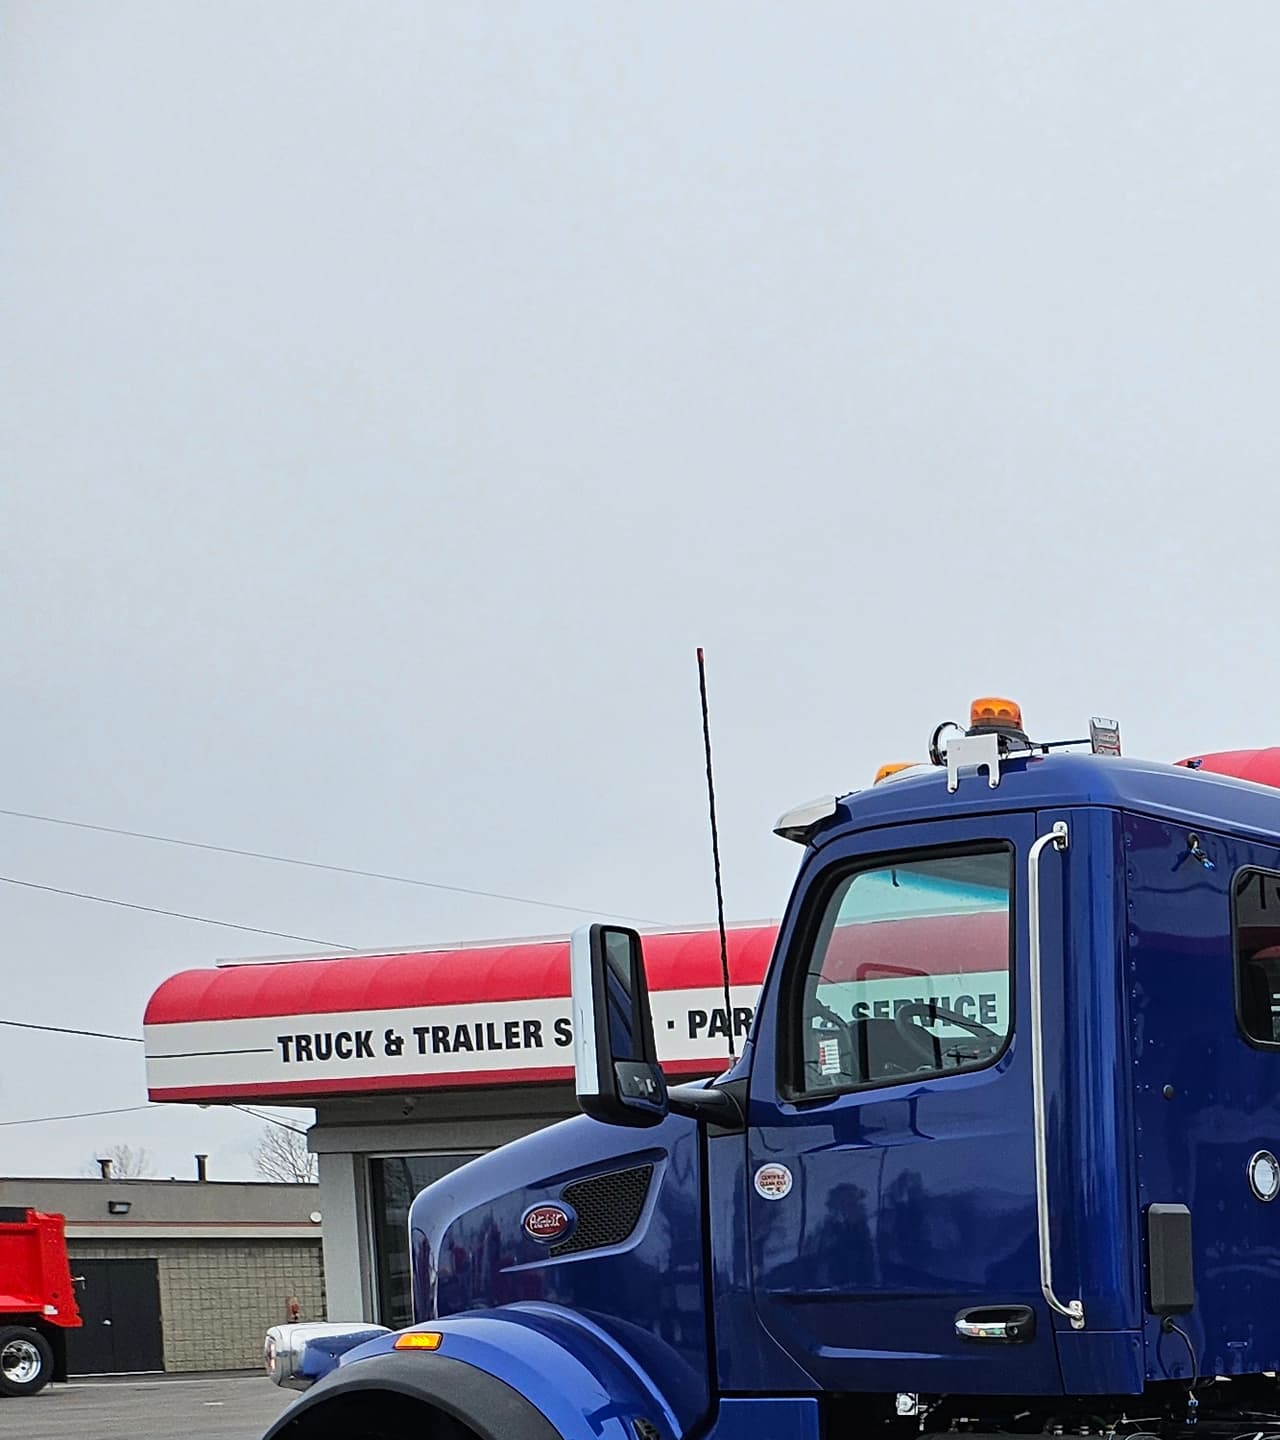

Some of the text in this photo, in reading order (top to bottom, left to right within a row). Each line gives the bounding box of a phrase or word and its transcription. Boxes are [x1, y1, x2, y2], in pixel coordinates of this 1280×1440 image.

[277, 1030, 375, 1062] TRUCK
[384, 1029, 404, 1056] &
[413, 1019, 543, 1054] TRAILER
[688, 1005, 755, 1039] PAR
